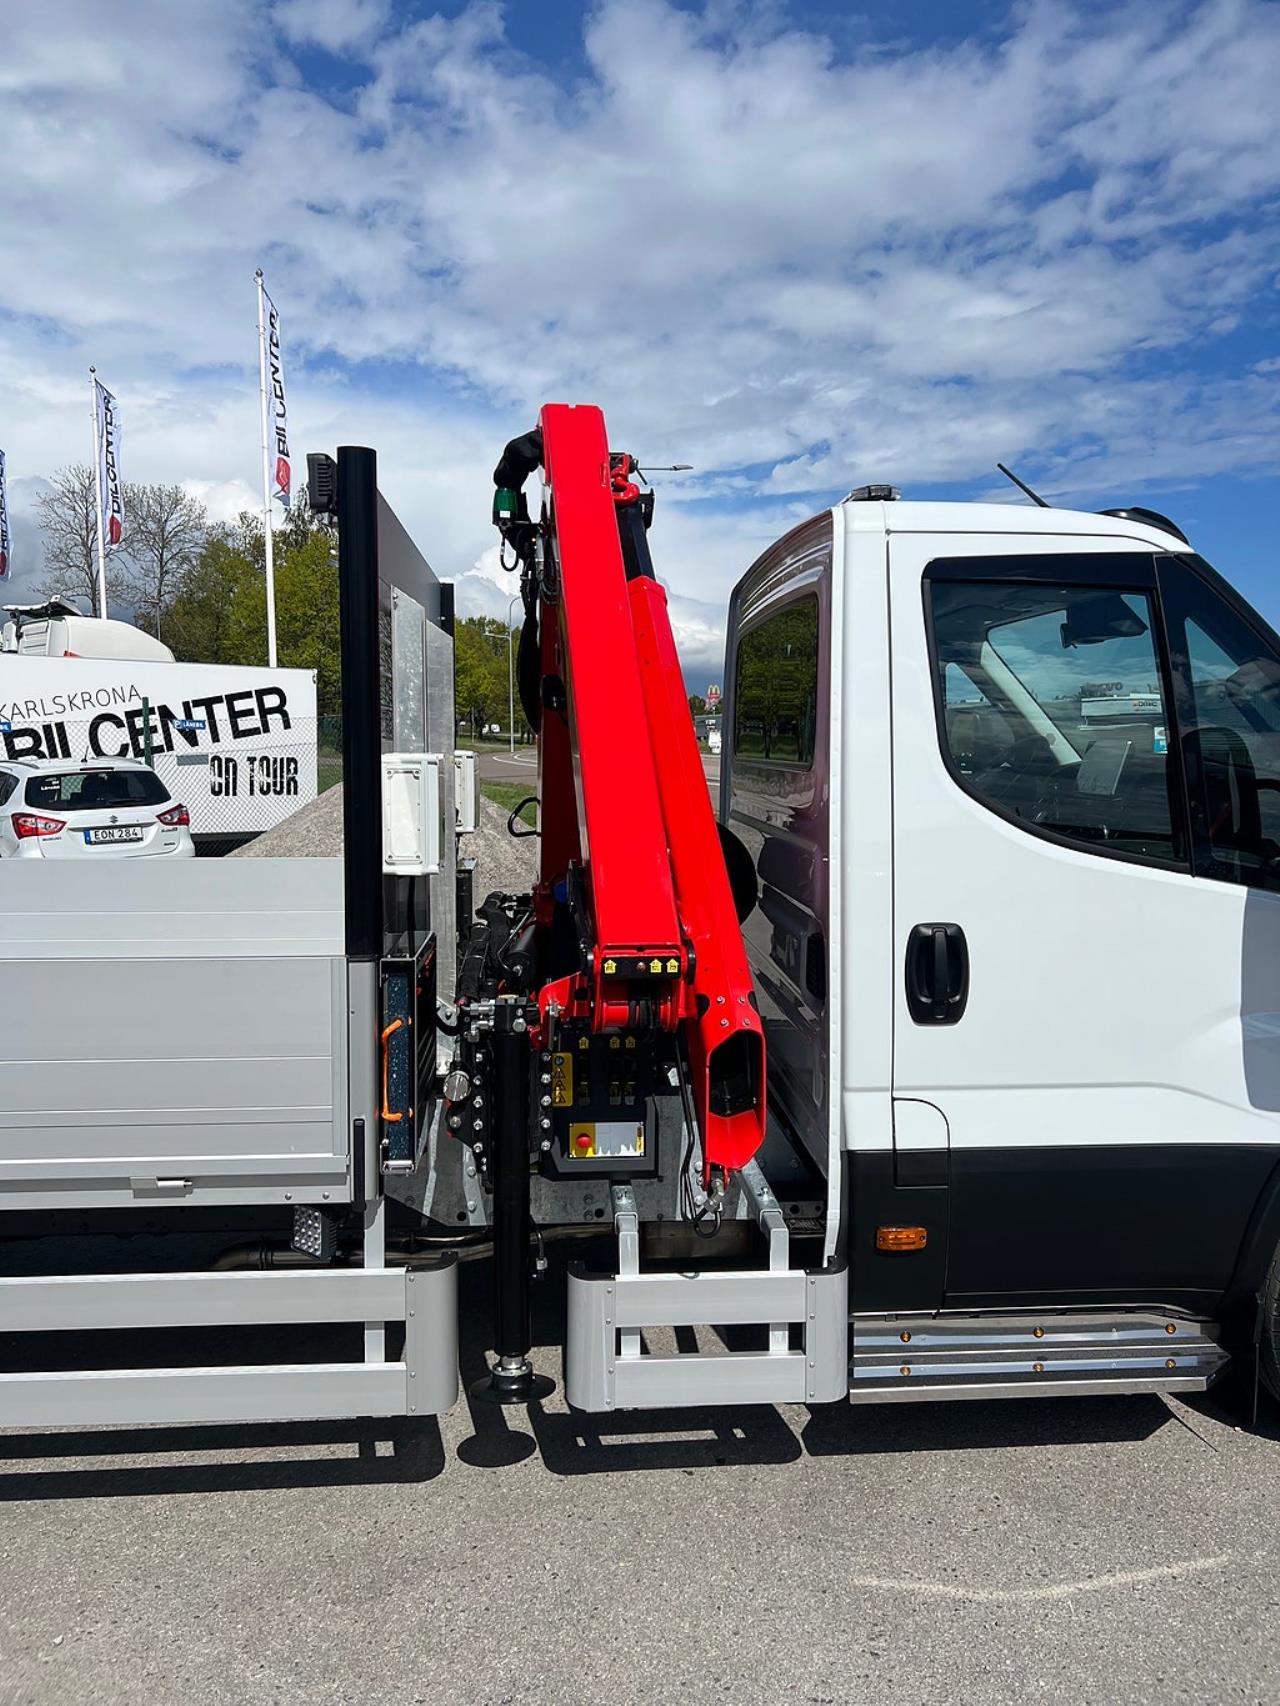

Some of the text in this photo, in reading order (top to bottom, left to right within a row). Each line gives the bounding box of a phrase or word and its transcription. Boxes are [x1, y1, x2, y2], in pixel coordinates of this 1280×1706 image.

[0, 685, 142, 721] KARLSKRONA
[89, 686, 291, 758] CENTER
[247, 755, 298, 796] TOUR
[94, 828, 138, 841] EON 284
